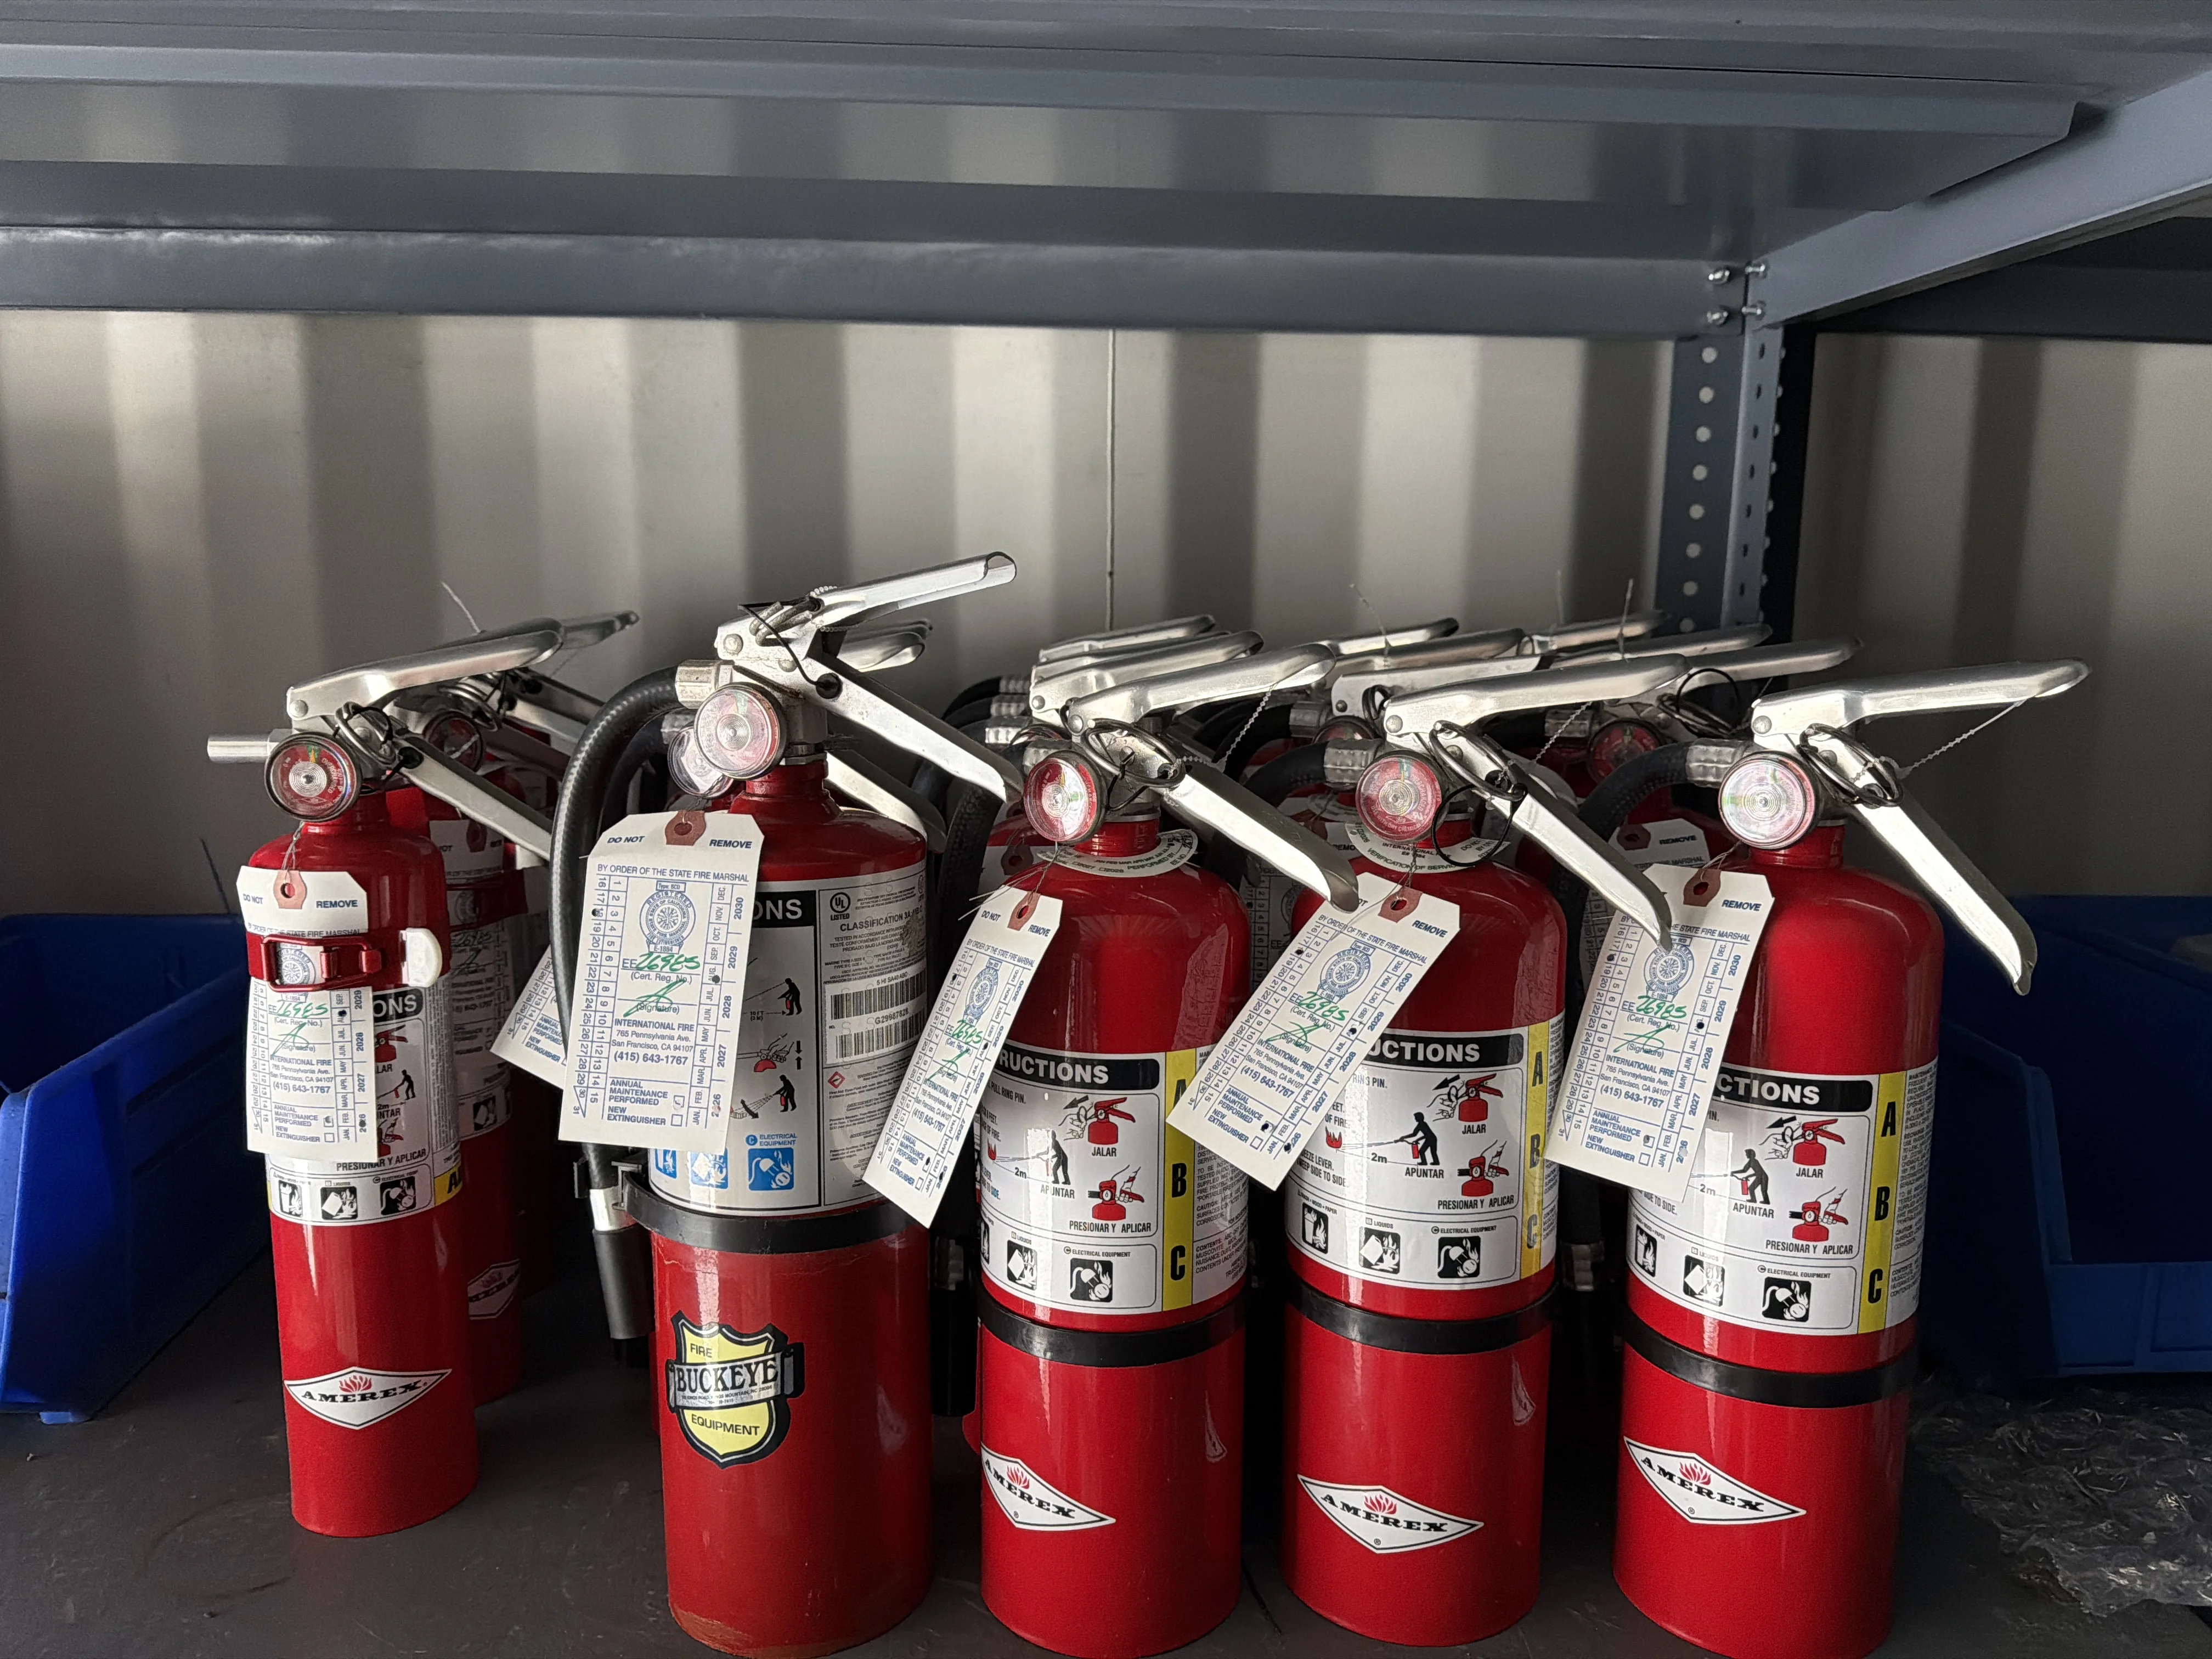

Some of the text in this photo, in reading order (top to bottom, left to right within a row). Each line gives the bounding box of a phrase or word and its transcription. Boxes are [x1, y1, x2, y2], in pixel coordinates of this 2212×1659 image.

[623, 834, 645, 844] NOT
[709, 839, 752, 849] REMOVE
[1659, 835, 1696, 845] REMOVE
[1127, 855, 1169, 870] PERFORMED
[1367, 848, 1412, 869] VERIFICATION
[610, 865, 637, 874] ORDER
[651, 868, 667, 876] THE
[669, 869, 691, 878] STATE
[693, 871, 711, 879] FIRE
[712, 872, 749, 882] MARSHAL
[242, 894, 263, 905] DO NOT
[316, 900, 358, 909] REMOVE
[1721, 899, 1761, 911] REMOVE
[734, 897, 744, 920] 2030
[840, 912, 903, 932] CLASSIFICATION
[988, 912, 1001, 921] NOT
[1027, 924, 1051, 937] REMOVE
[1412, 919, 1447, 938] REMOVE
[1679, 925, 1752, 941] STATE FIRE MARSHAL
[1318, 914, 1429, 964] BY ORDER OF THE STATE FIRE MARSHAL
[622, 958, 637, 968] EE
[727, 946, 738, 969] 2029
[630, 972, 692, 984] (Cert. Reg. No.)
[1395, 972, 1413, 992] 2030
[721, 995, 732, 1018] 2028
[614, 1018, 695, 1031] INTERNATIONAL FIRE
[1367, 1011, 1385, 1031] 2029
[630, 1031, 674, 1042] Pennsylvania
[701, 1027, 709, 1042] MAY
[625, 1040, 659, 1050] Francisco,
[613, 1050, 688, 1065] (415) 643-1767
[698, 1047, 707, 1063] APR.
[716, 1044, 726, 1068] 2027
[1256, 1038, 1314, 1073] INTERNATIONAL FIRE
[1339, 1051, 1357, 1071] 2028
[696, 1066, 705, 1084] MAR.
[1532, 1051, 1543, 1087] A
[273, 1082, 330, 1094] (415) 643-1767
[610, 1079, 644, 1088] ANNUAL
[1239, 1064, 1294, 1099] (415) 643-1767
[1372, 1078, 1387, 1089] PIN.
[608, 1094, 659, 1106] PERFORMED
[609, 1087, 668, 1098] MAINTENANCE
[1002, 1087, 1026, 1104] RING PIN.
[1599, 1084, 1663, 1108] (415) 643-1767
[608, 1105, 627, 1114] NEW
[1311, 1091, 1330, 1113] 2027
[607, 1113, 666, 1125] EXTINGUISHER
[692, 1109, 700, 1125] JAN.
[1881, 1101, 1896, 1137] A
[1462, 1124, 1486, 1135] JALAR
[395, 1148, 426, 1164] APLICAR
[1092, 1147, 1116, 1156] JALAR
[1371, 1153, 1388, 1163] 2m
[1530, 1133, 1541, 1169] B
[1316, 1157, 1334, 1171] LEVER.
[1015, 1167, 1026, 1178] 2m
[1172, 1162, 1187, 1198] B
[1310, 1165, 1349, 1187] SIDE TO SIDE.
[1404, 1166, 1444, 1179] APUNTAR
[1796, 1167, 1824, 1178] JALAR
[1041, 1185, 1075, 1199] APUNTAR
[1700, 1184, 1716, 1196] 2m
[1197, 1199, 1218, 1212] CAUTION:
[1438, 1195, 1514, 1210] PRESIONAR Y APLICAR
[1655, 1197, 1677, 1215] TO SIDE.
[1875, 1186, 1889, 1221] B
[1733, 1203, 1774, 1218] APUNTAR
[1069, 1220, 1151, 1233] PRESIONAR Y APLICAR
[1374, 1220, 1393, 1229] LIQUIDS
[1470, 1225, 1497, 1234] EQUIPMENT
[1527, 1214, 1538, 1249] C
[1196, 1238, 1222, 1252] CONTENTS:
[1765, 1240, 1853, 1255] PRESIONAR Y APLICAR
[1072, 1249, 1101, 1257] ELECTRICAL
[1170, 1245, 1186, 1281] C
[1767, 1268, 1799, 1277] ELECTRICAL
[1867, 1268, 1883, 1304] C
[690, 1343, 713, 1358] FIRE
[676, 1358, 778, 1393] BUCKEYE
[302, 1380, 421, 1403] AMEREX
[691, 1414, 760, 1436] EQUIPMENT
[985, 1459, 1075, 1519] AMEREX
[1641, 1457, 1764, 1513] AMEREX
[1321, 1494, 1448, 1532] AMEREX
